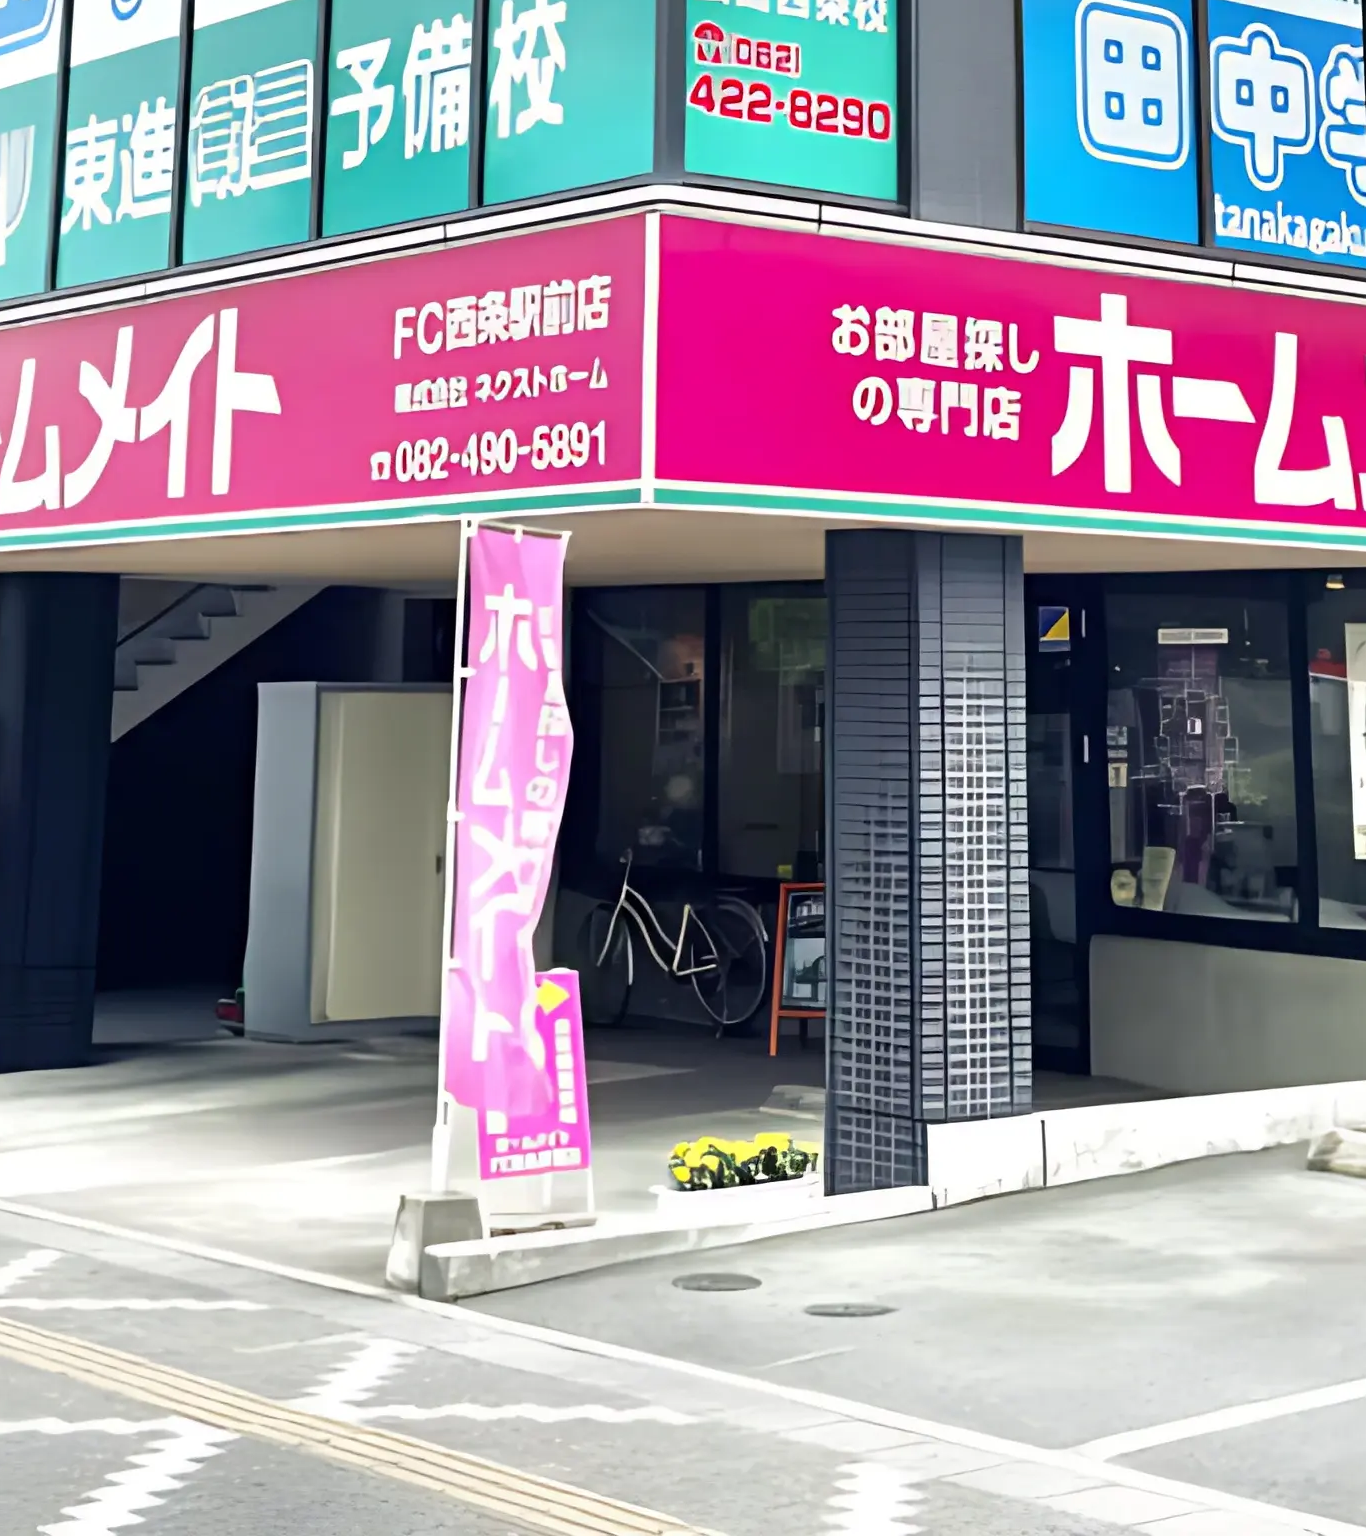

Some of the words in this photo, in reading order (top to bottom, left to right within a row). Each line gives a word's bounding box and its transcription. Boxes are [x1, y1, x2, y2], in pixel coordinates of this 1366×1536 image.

[689, 73, 891, 142] 422-8290
[831, 303, 1040, 374] お部屋探し
[852, 376, 1022, 441] の専門店
